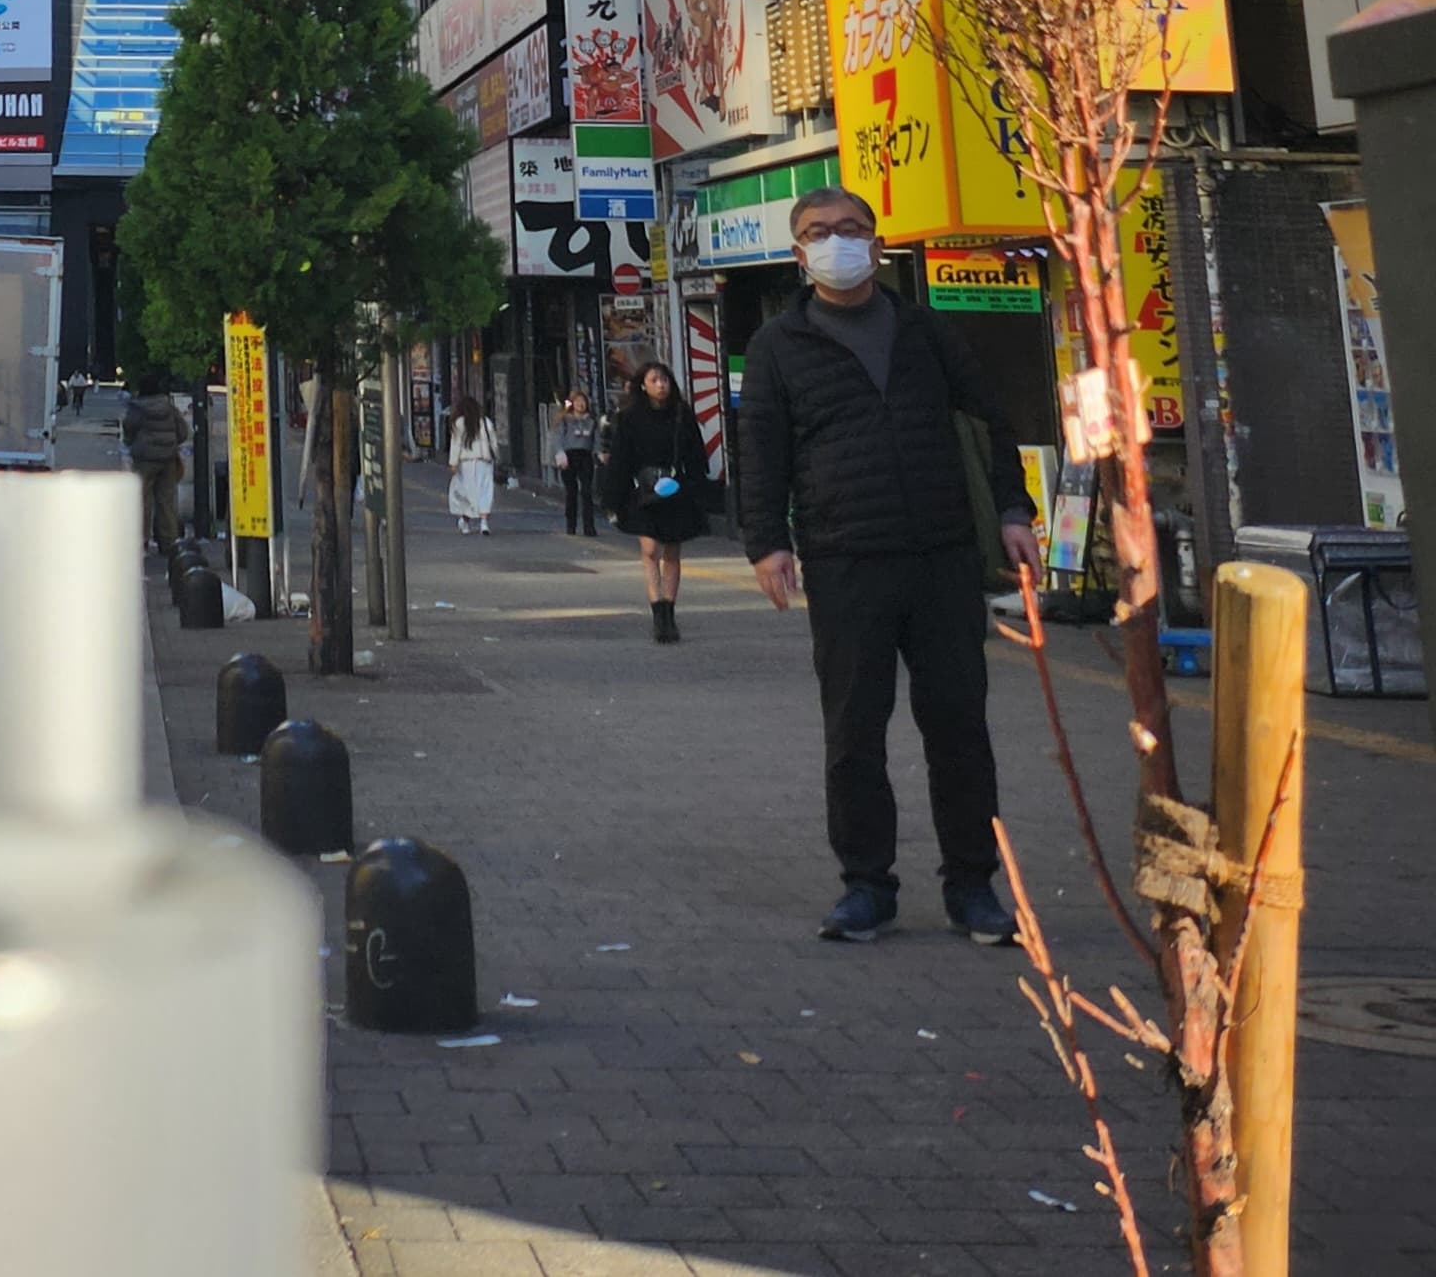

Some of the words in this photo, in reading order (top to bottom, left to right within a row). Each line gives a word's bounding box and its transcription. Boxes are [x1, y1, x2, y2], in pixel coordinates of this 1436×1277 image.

[581, 165, 649, 180] FamilyMart
[719, 211, 765, 249] FamilyMart
[935, 263, 1031, 287] Garam
